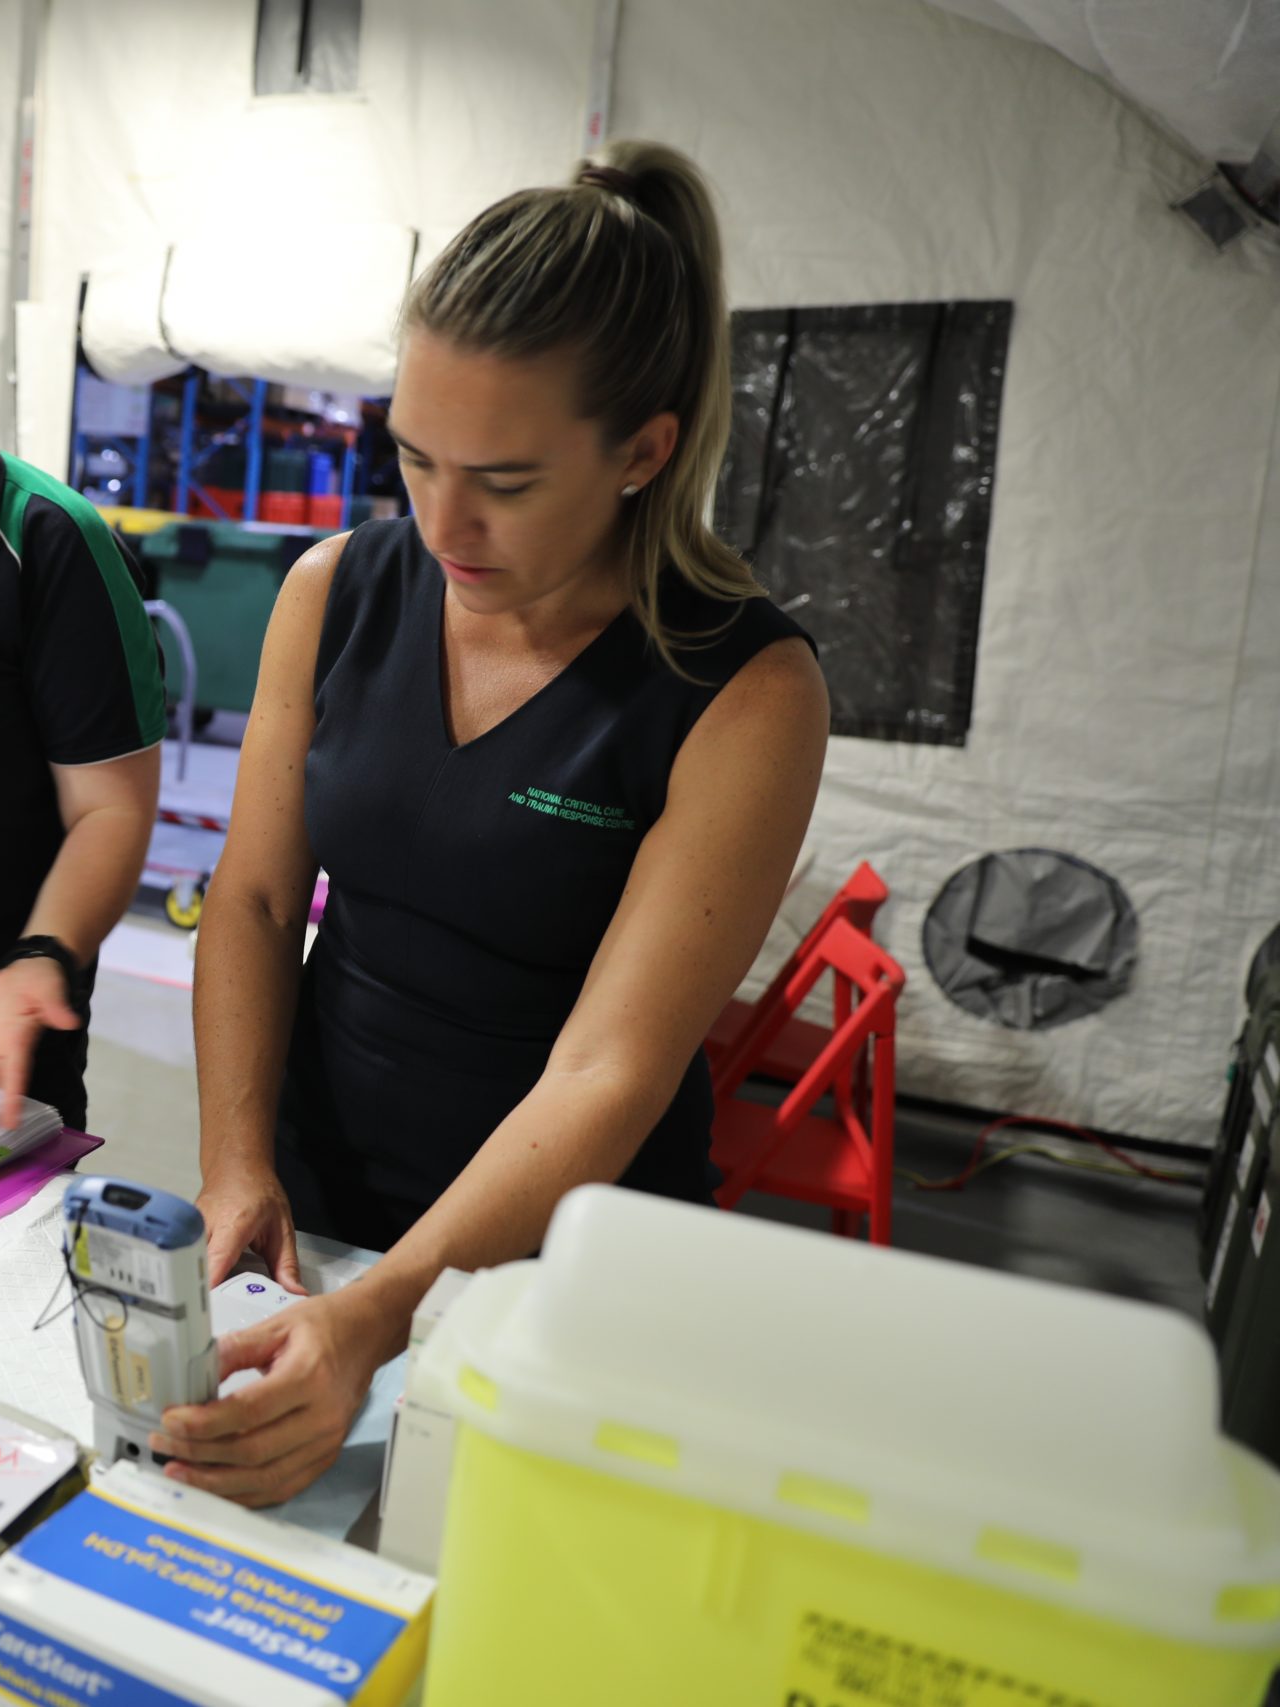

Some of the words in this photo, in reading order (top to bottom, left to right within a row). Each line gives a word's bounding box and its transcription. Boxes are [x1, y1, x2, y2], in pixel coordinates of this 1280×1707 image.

[508, 792, 526, 805] AND
[526, 798, 558, 816] TRAUMA
[558, 808, 605, 827] RESPONSE
[526, 786, 562, 805] NATIONAL
[563, 798, 602, 815] CRITICAL
[146, 1533, 233, 1578] Combo
[230, 1590, 330, 1641] Malaria
